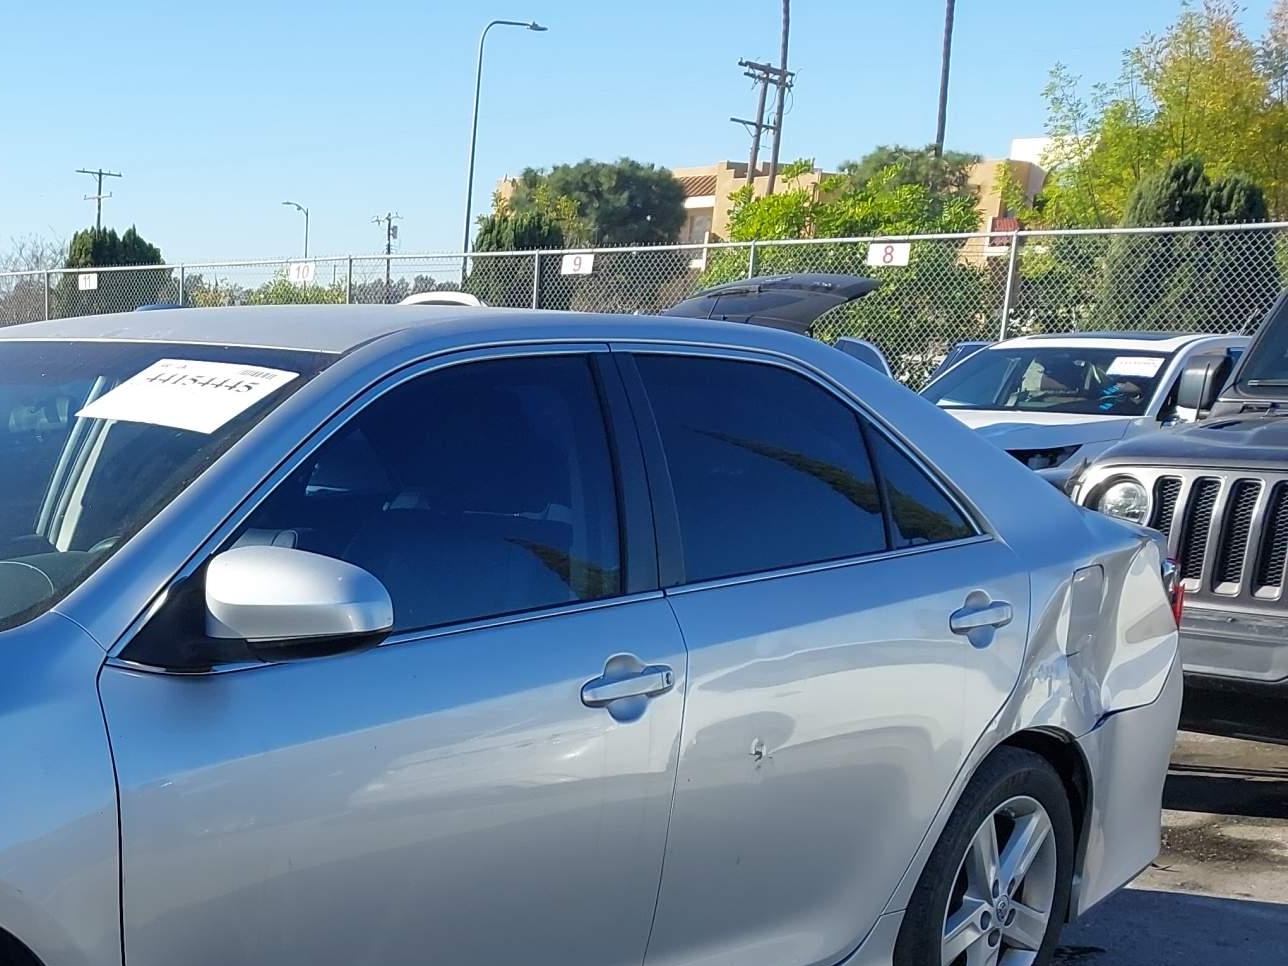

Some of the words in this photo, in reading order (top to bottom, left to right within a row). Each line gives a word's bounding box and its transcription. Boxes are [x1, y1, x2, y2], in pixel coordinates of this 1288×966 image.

[882, 245, 895, 264] 8
[294, 264, 310, 280] 10
[572, 256, 582, 272] 9
[83, 275, 91, 289] 11
[146, 372, 260, 393] 44154445
